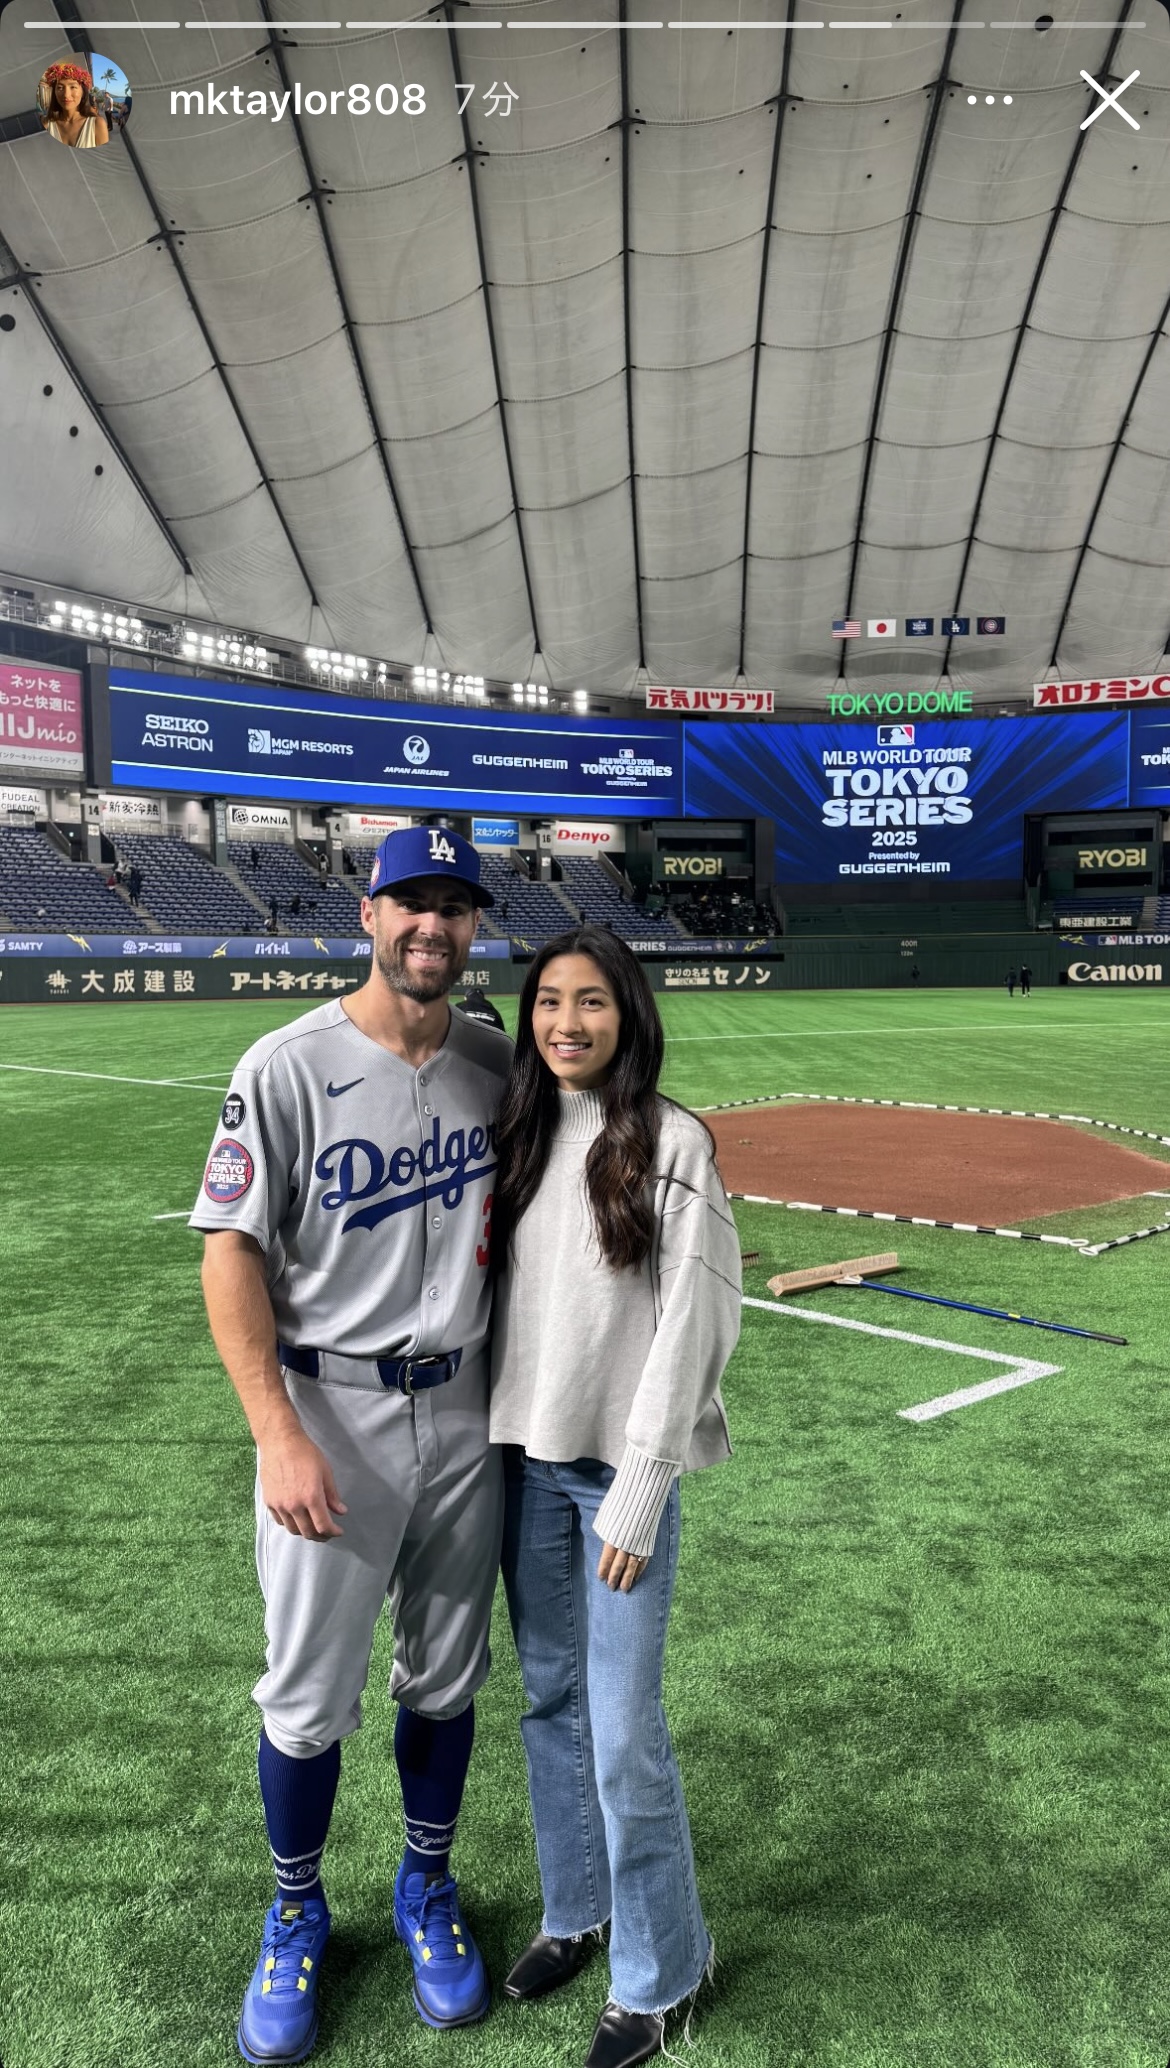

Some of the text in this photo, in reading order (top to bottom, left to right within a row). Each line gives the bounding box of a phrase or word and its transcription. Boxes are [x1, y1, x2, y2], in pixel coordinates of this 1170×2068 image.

[11, 674, 61, 693] ネットを
[1038, 676, 1170, 705] オロナミンC
[0, 691, 76, 712] もっと快適に
[826, 690, 973, 717] TOKYO DOME
[145, 714, 209, 734] SEIKO
[141, 732, 213, 752] ASTRON
[271, 738, 354, 755] MGM RESORTS
[472, 754, 568, 770] GUGGENHEIM
[823, 747, 972, 765] MLB WORLD TOUR
[383, 766, 450, 777] JAPAN AIRLINES
[580, 763, 673, 777] TOKYO SERIES
[825, 765, 968, 797] TOKYO
[89, 805, 99, 815] 14
[822, 796, 974, 827] SERIES
[252, 815, 291, 826] OMNIA
[542, 835, 551, 843] 16
[557, 829, 611, 845] Denyo
[872, 831, 918, 847] 2025
[428, 830, 456, 863] LA
[664, 856, 722, 875] RYOBI
[869, 852, 920, 862] Presented by
[1078, 848, 1147, 868] RYOBI
[839, 862, 950, 874] GUGGENHEIM
[1059, 916, 1132, 928] 東亜建設工業
[8, 941, 43, 951] SAMTY
[1119, 935, 1144, 945] MLB
[352, 943, 371, 957] JTB
[665, 968, 710, 978] 守りの名手
[713, 966, 771, 985] セノン
[1067, 961, 1163, 982] Canon
[81, 969, 195, 994] 大成建設
[230, 971, 358, 991] アートネイチャー
[225, 1106, 239, 1124] 34
[210, 1163, 244, 1175] TOKYO
[207, 1174, 246, 1185] SERIES
